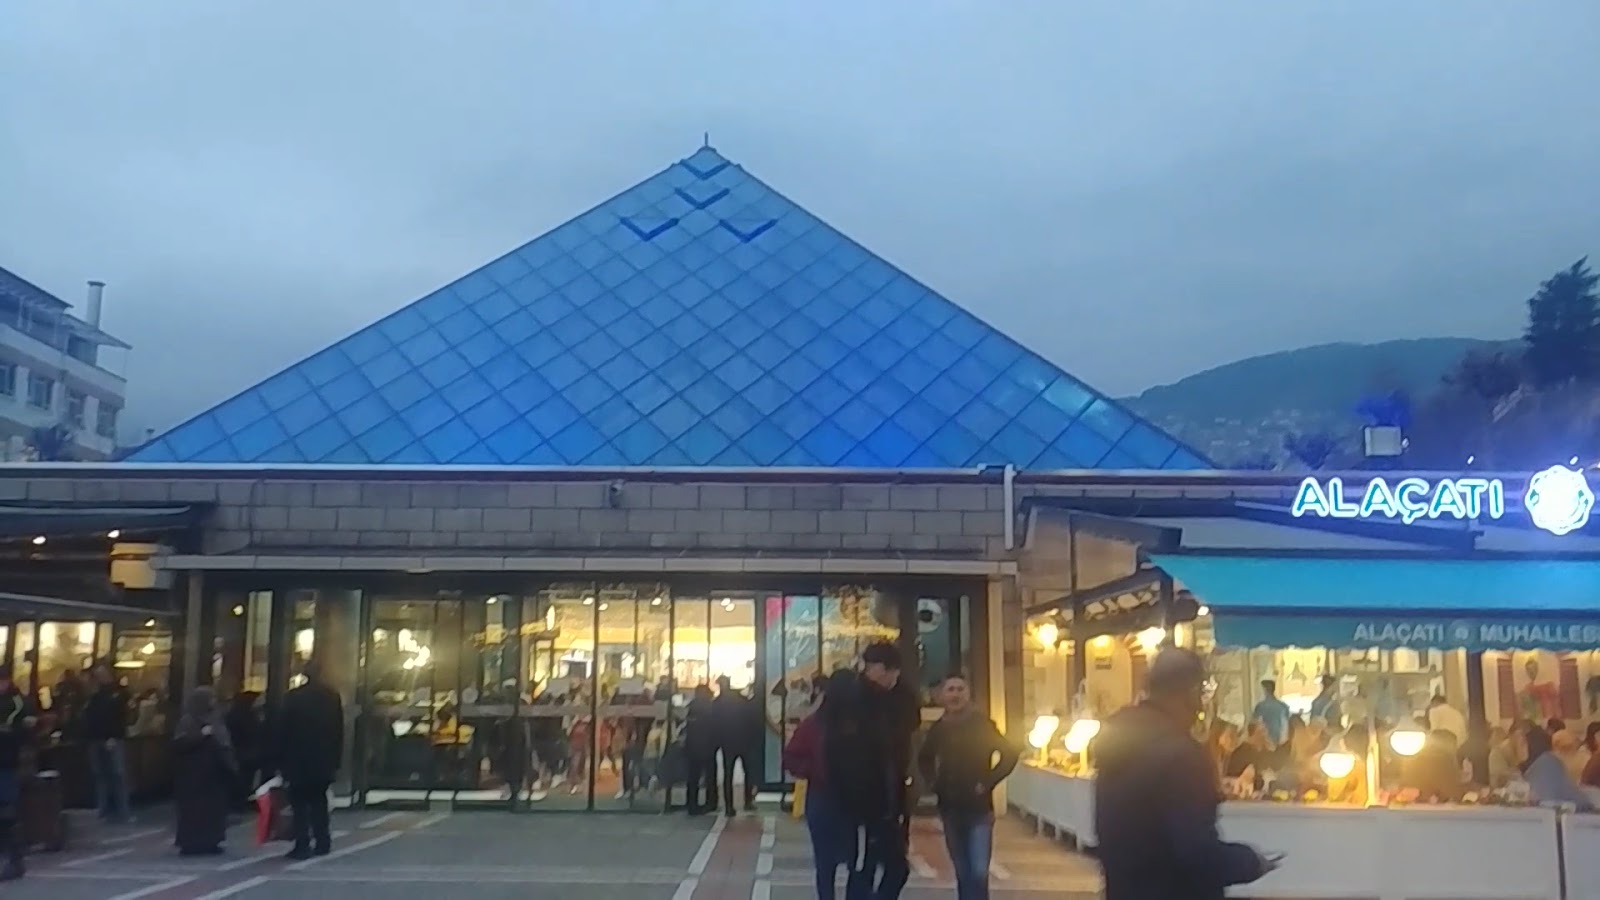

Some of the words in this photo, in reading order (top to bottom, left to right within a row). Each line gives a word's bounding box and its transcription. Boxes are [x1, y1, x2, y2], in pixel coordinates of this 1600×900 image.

[1292, 477, 1503, 524] ALAÇATI
[1353, 623, 1444, 645] ALAÇATI
[1480, 624, 1600, 643] MUHALLEB
